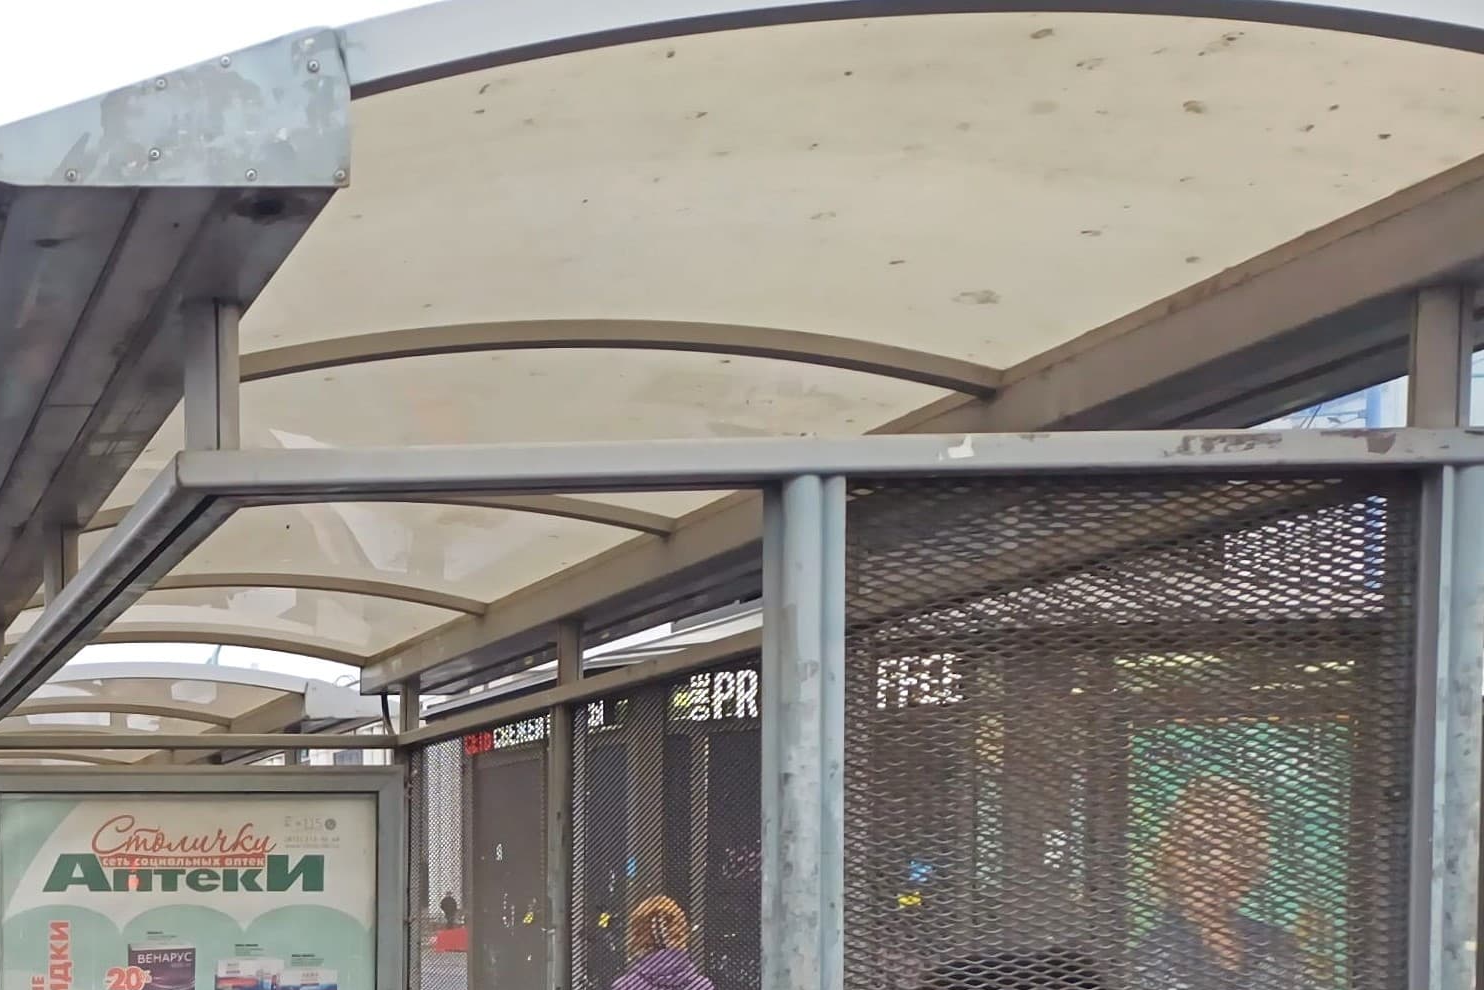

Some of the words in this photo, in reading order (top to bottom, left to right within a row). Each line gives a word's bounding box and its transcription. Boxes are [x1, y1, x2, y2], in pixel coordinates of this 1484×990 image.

[92, 814, 276, 854] Столички
[103, 856, 130, 867] сеть
[135, 856, 220, 869] социальных
[225, 857, 265, 866] аптек
[137, 951, 192, 964] ВЕНАРУС
